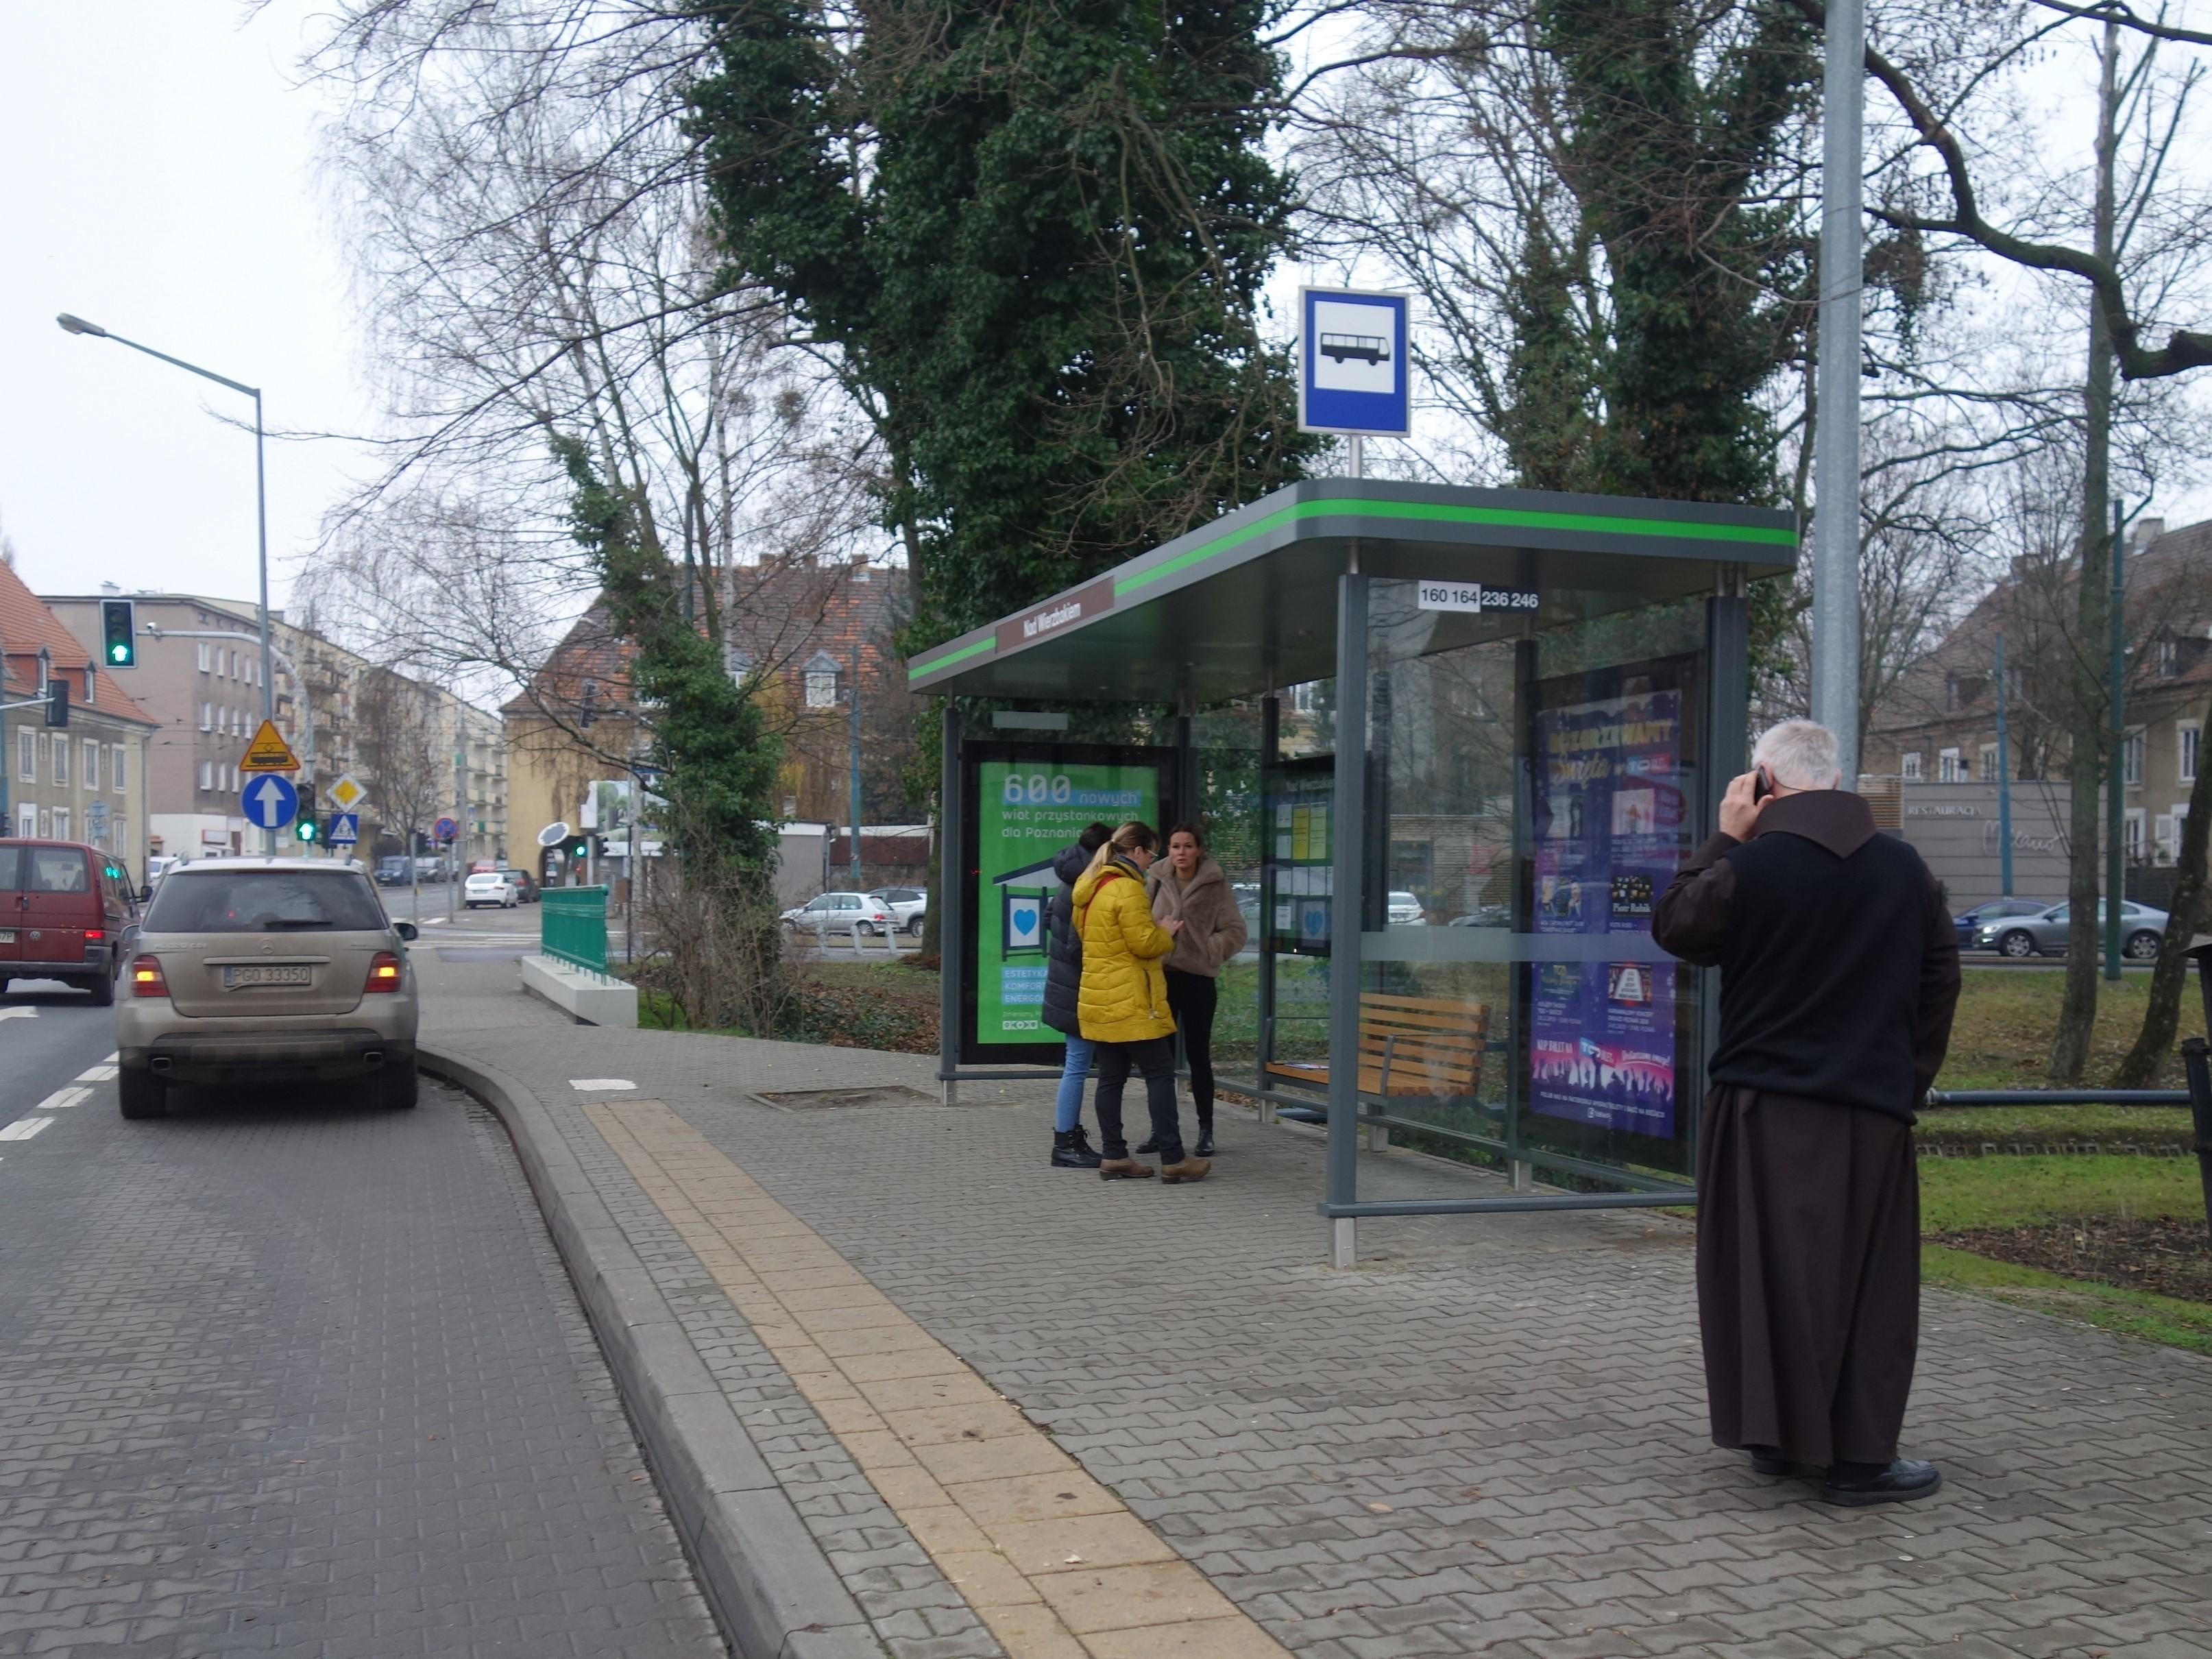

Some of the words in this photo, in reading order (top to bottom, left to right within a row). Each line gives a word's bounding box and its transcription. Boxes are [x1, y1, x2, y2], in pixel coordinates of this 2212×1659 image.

[1421, 588, 1447, 603] 160
[1452, 590, 1478, 604] 164
[1481, 591, 1509, 607] 236
[1511, 593, 1539, 608] 246
[1023, 616, 1037, 638] Nad
[1004, 774, 1071, 803] 600
[1080, 792, 1137, 806] nowych
[1001, 809, 1030, 821] wiat
[1034, 810, 1139, 823] przystankowych
[1001, 826, 1021, 838] dla
[1982, 820, 2064, 857] Mlano
[234, 967, 260, 982] PGO
[265, 967, 308, 982] 33350
[1005, 970, 1048, 978] ESTETYKA
[1005, 982, 1047, 990] KOMFORT
